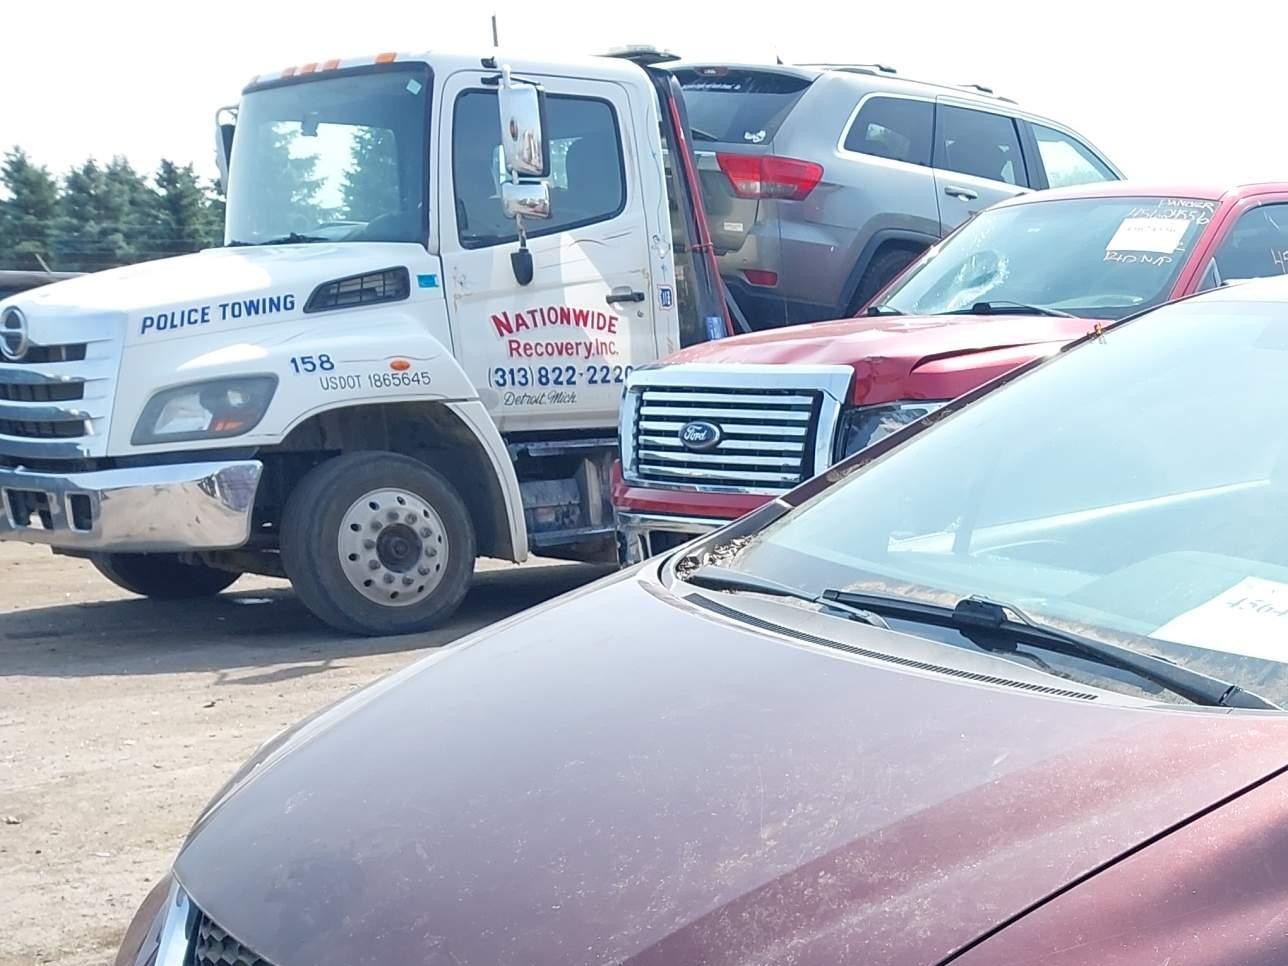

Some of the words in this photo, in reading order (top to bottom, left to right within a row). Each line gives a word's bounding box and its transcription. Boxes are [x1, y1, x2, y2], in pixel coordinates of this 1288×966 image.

[141, 306, 211, 334] POLICE
[219, 294, 296, 321] TOWING
[491, 306, 619, 337] NATIONWIDE
[290, 354, 335, 373] 158
[320, 374, 362, 391] USDOT
[368, 371, 431, 388] 1865645
[683, 425, 708, 441] Ford
